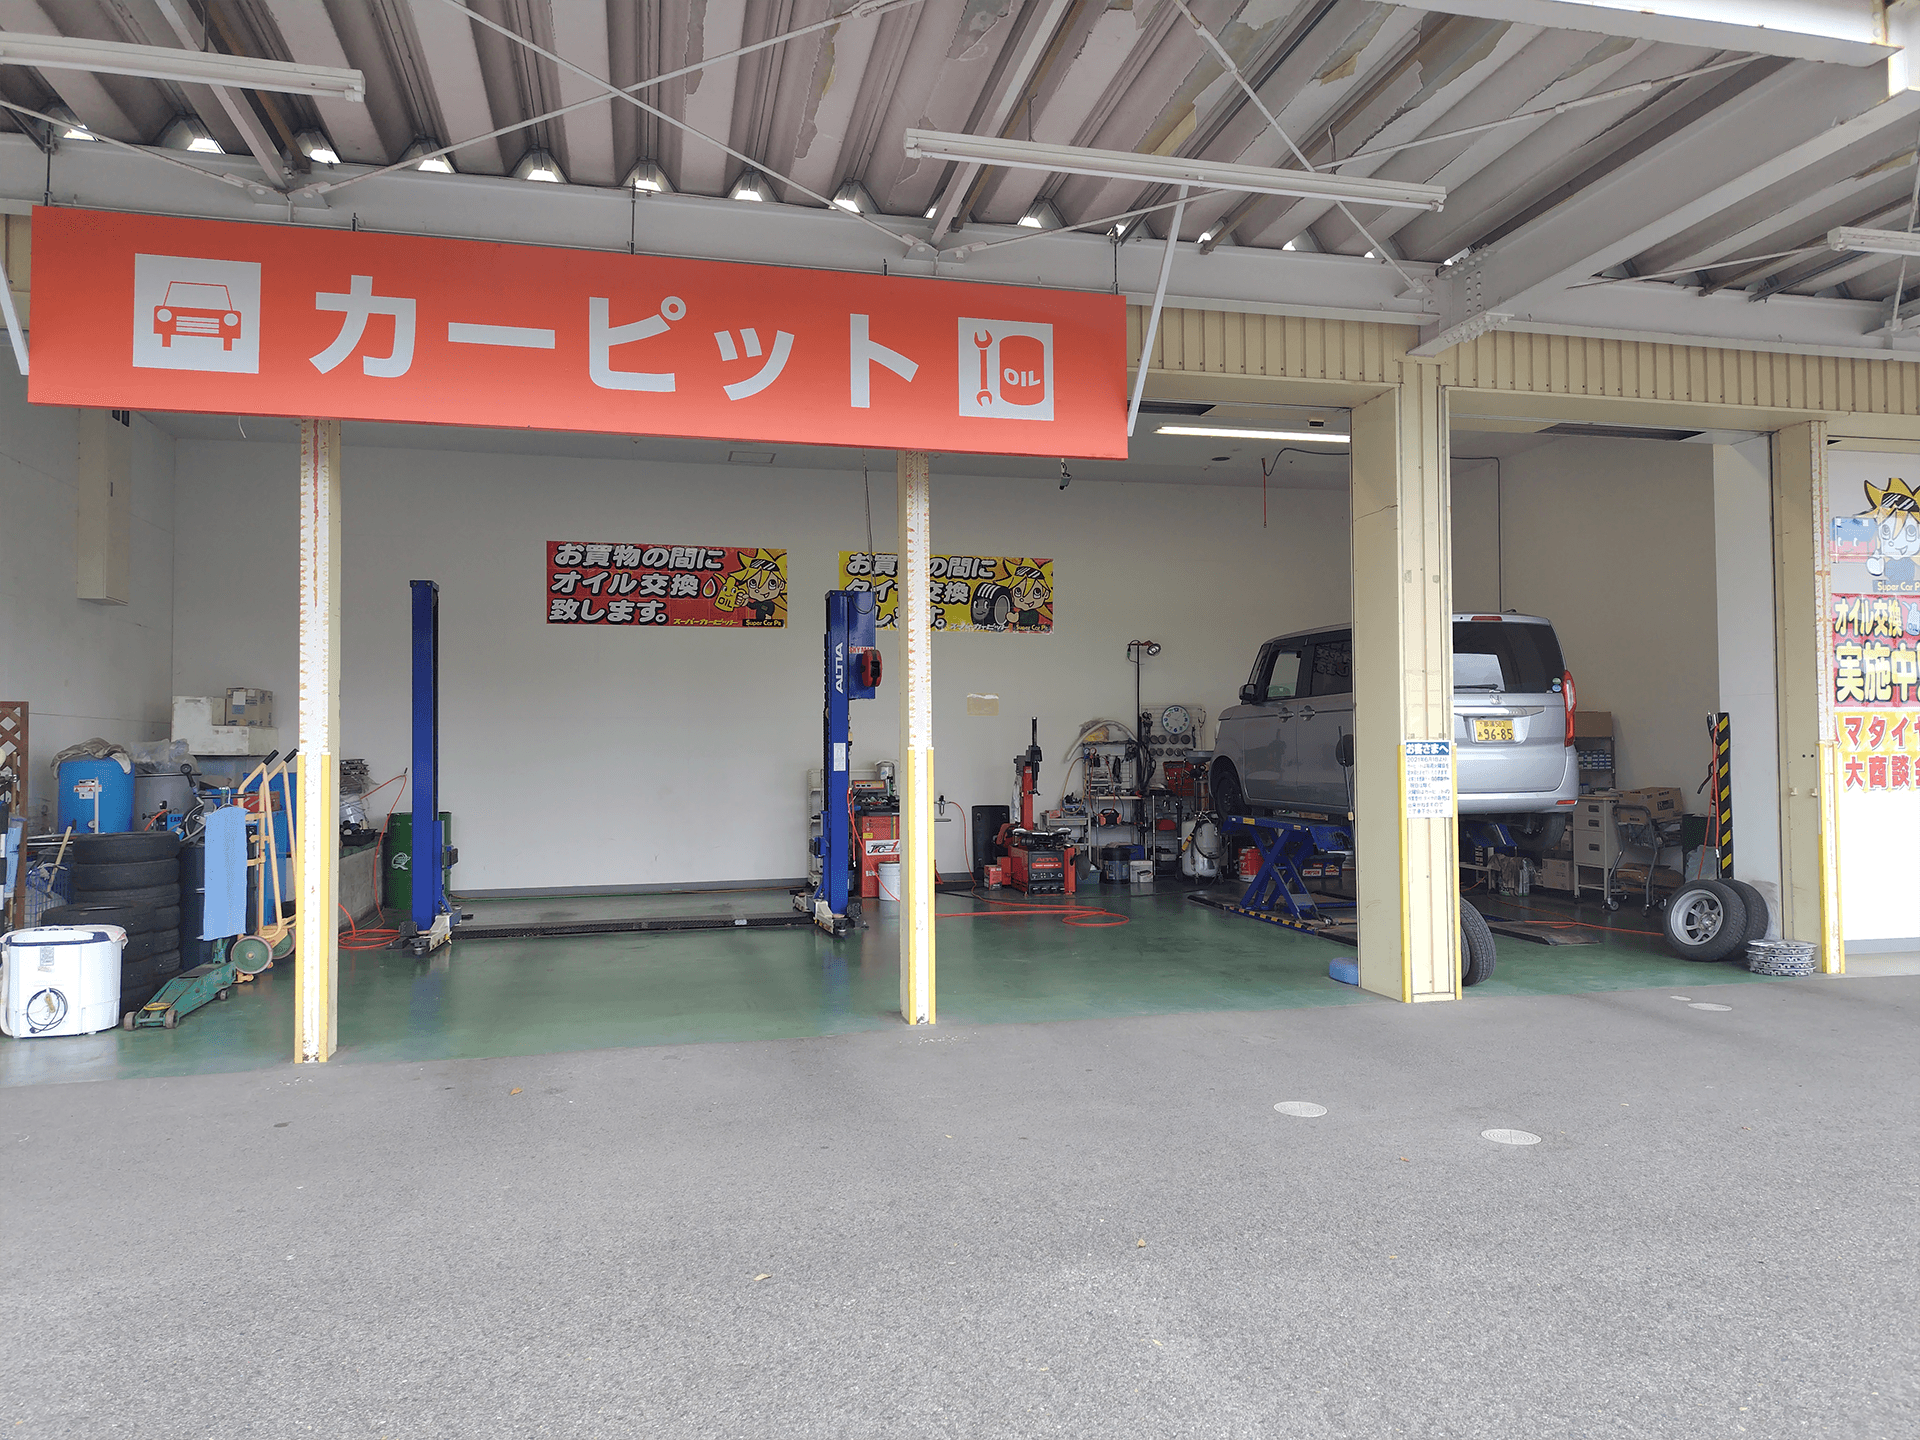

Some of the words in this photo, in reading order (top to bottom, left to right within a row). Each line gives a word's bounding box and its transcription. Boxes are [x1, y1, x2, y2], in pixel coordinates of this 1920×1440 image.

[309, 275, 919, 408] カーピット
[1003, 368, 1041, 387] OIL
[554, 543, 725, 571] お買物の間に
[846, 553, 997, 579] お買の間に
[549, 570, 702, 599] オイル交換
[1877, 581, 1899, 591] Super
[1900, 581, 1913, 591] Car
[548, 598, 669, 624] 致します。
[718, 597, 732, 608] OIL
[673, 618, 738, 626] スーパーカーピット
[1834, 598, 1904, 638] オイル交換
[835, 642, 844, 694] ALTIA
[1835, 640, 1920, 703] 実施中
[1483, 728, 1513, 740] 96-85
